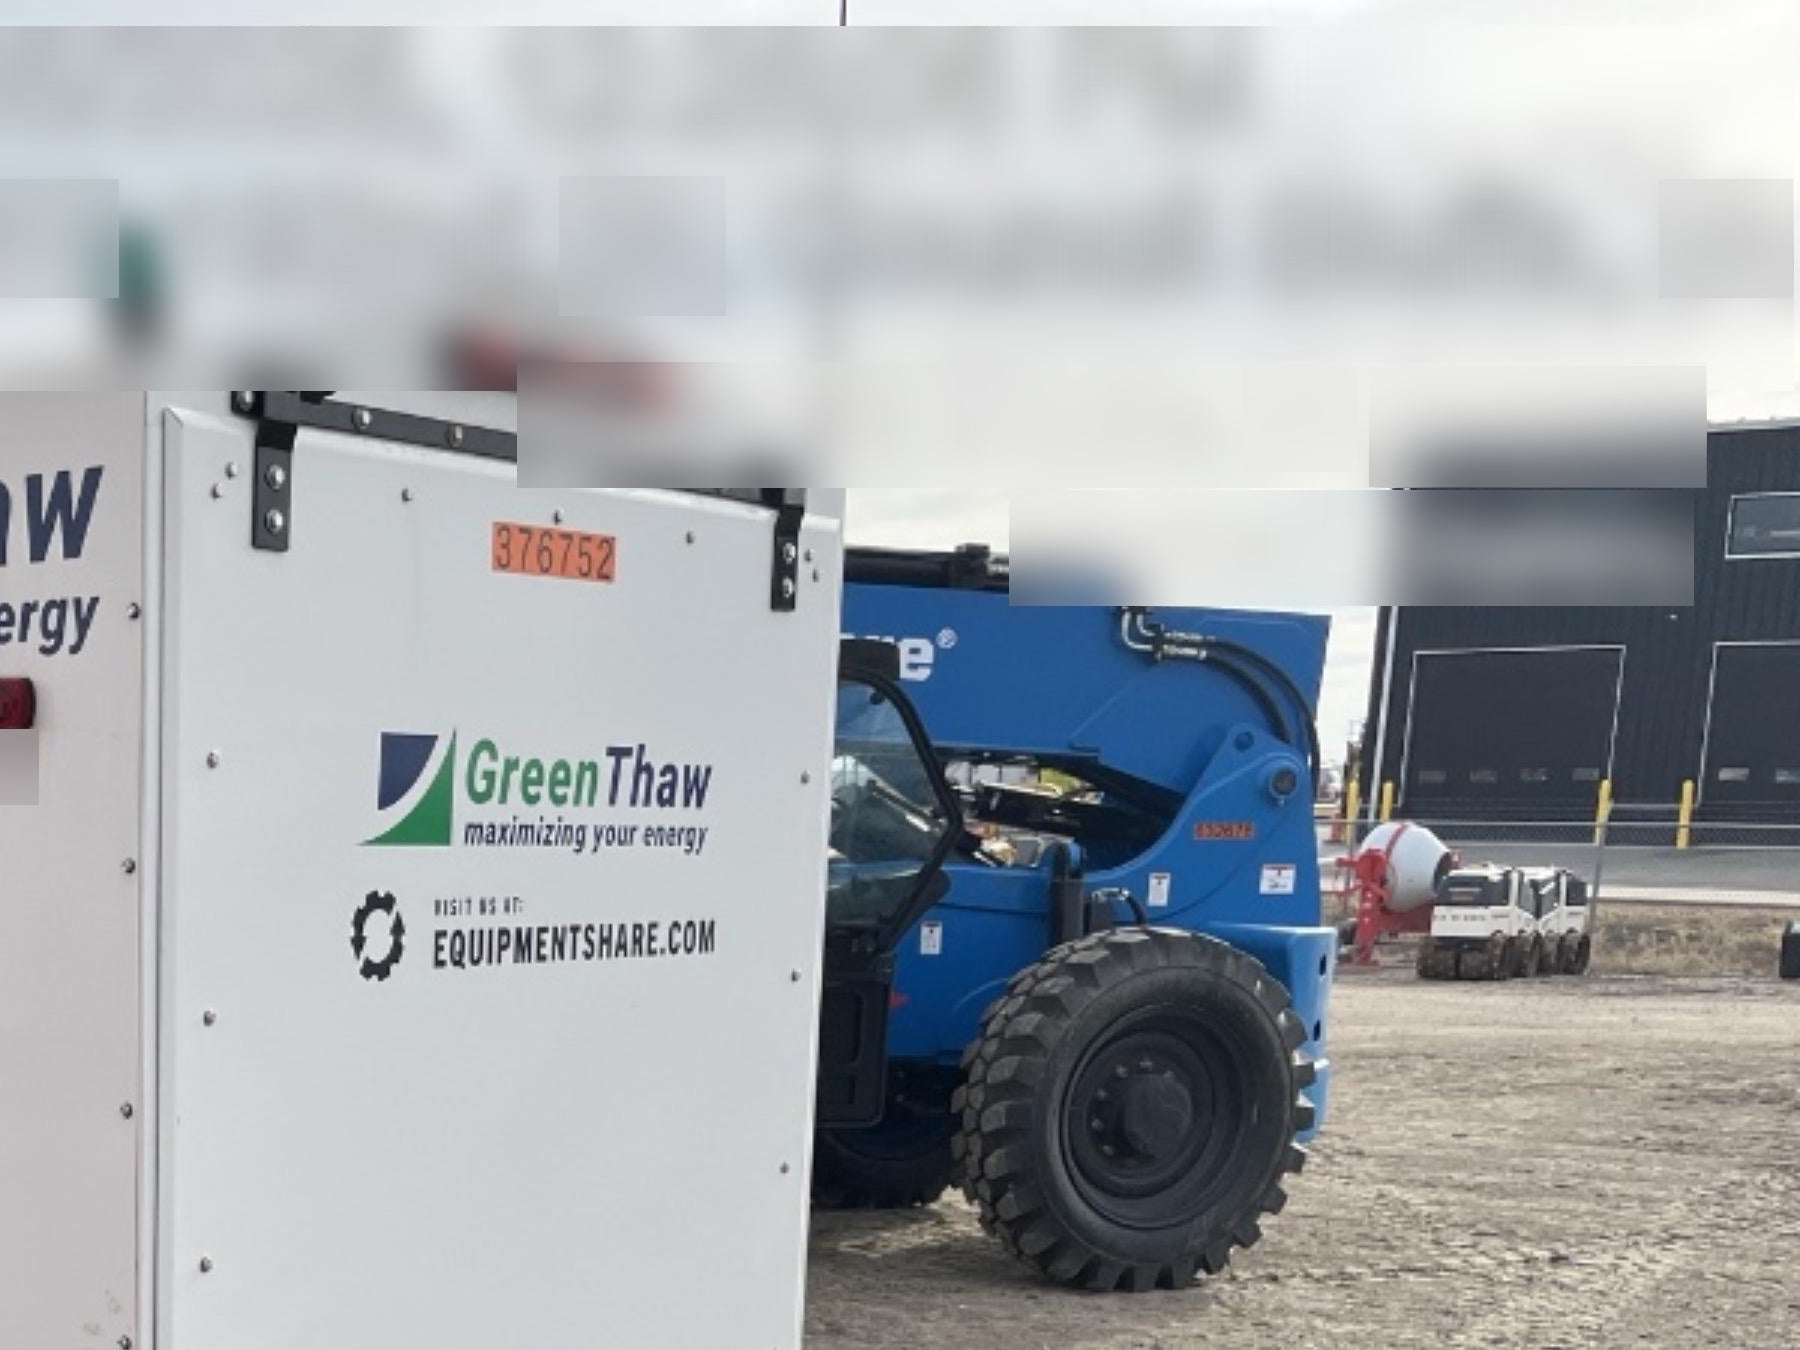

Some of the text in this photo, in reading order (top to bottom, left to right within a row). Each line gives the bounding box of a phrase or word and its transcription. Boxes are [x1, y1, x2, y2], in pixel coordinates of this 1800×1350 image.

[495, 525, 614, 580] 376752
[463, 816, 710, 856] maximizing your energy
[434, 897, 472, 917] VISIT
[433, 918, 716, 970] EQUIPMENTSHARE.COM
